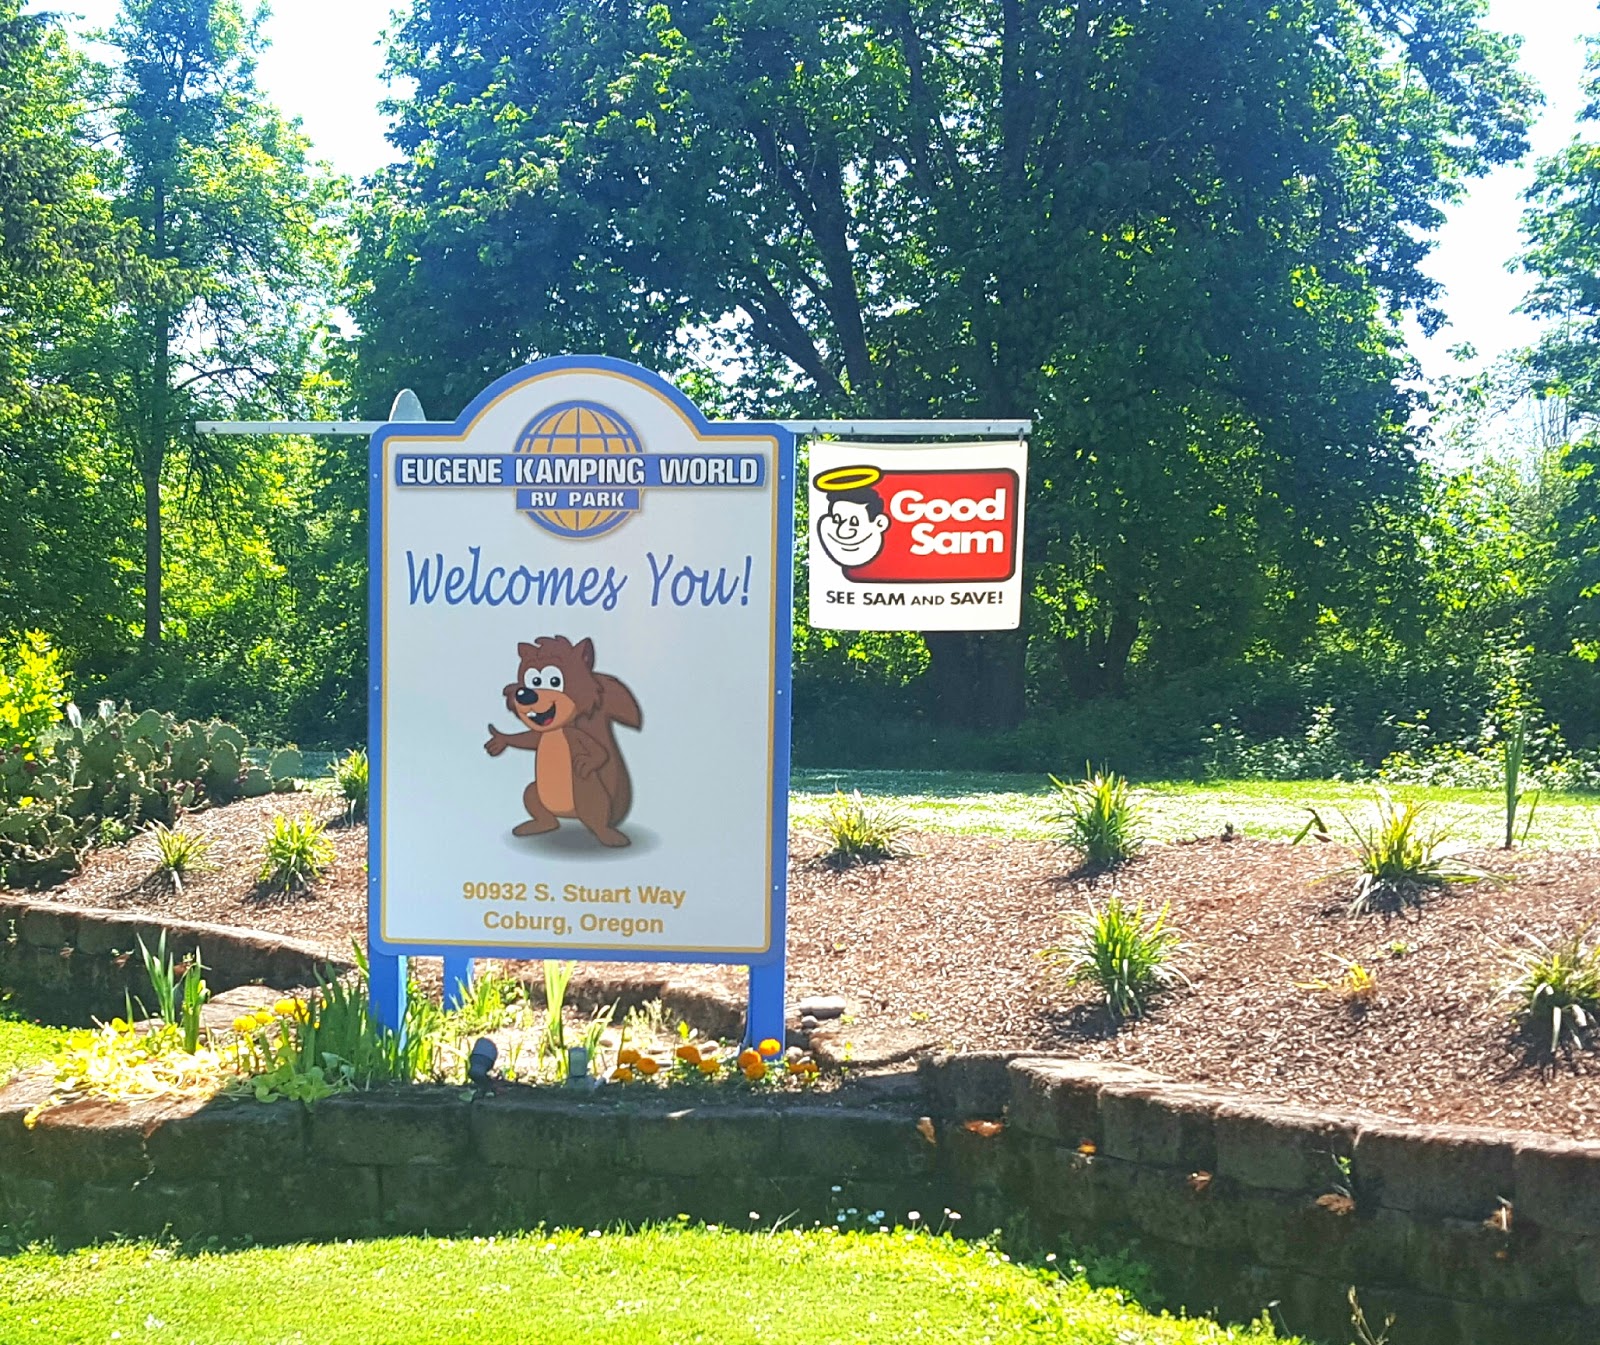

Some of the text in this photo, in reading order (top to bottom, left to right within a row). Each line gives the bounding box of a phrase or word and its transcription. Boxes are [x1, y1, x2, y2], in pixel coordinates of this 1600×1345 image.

[401, 458, 758, 485] EUGENE KAMPING WORLD
[531, 491, 625, 507] RV PARK
[890, 488, 1006, 523] Good
[909, 523, 1004, 555] Sam
[406, 546, 752, 611] Welcomes You!
[826, 590, 1003, 606] SEE SAM AND SAVE!
[462, 881, 686, 909] 90932 S. Stuart Way
[483, 911, 664, 937] Coburg, Oregon
